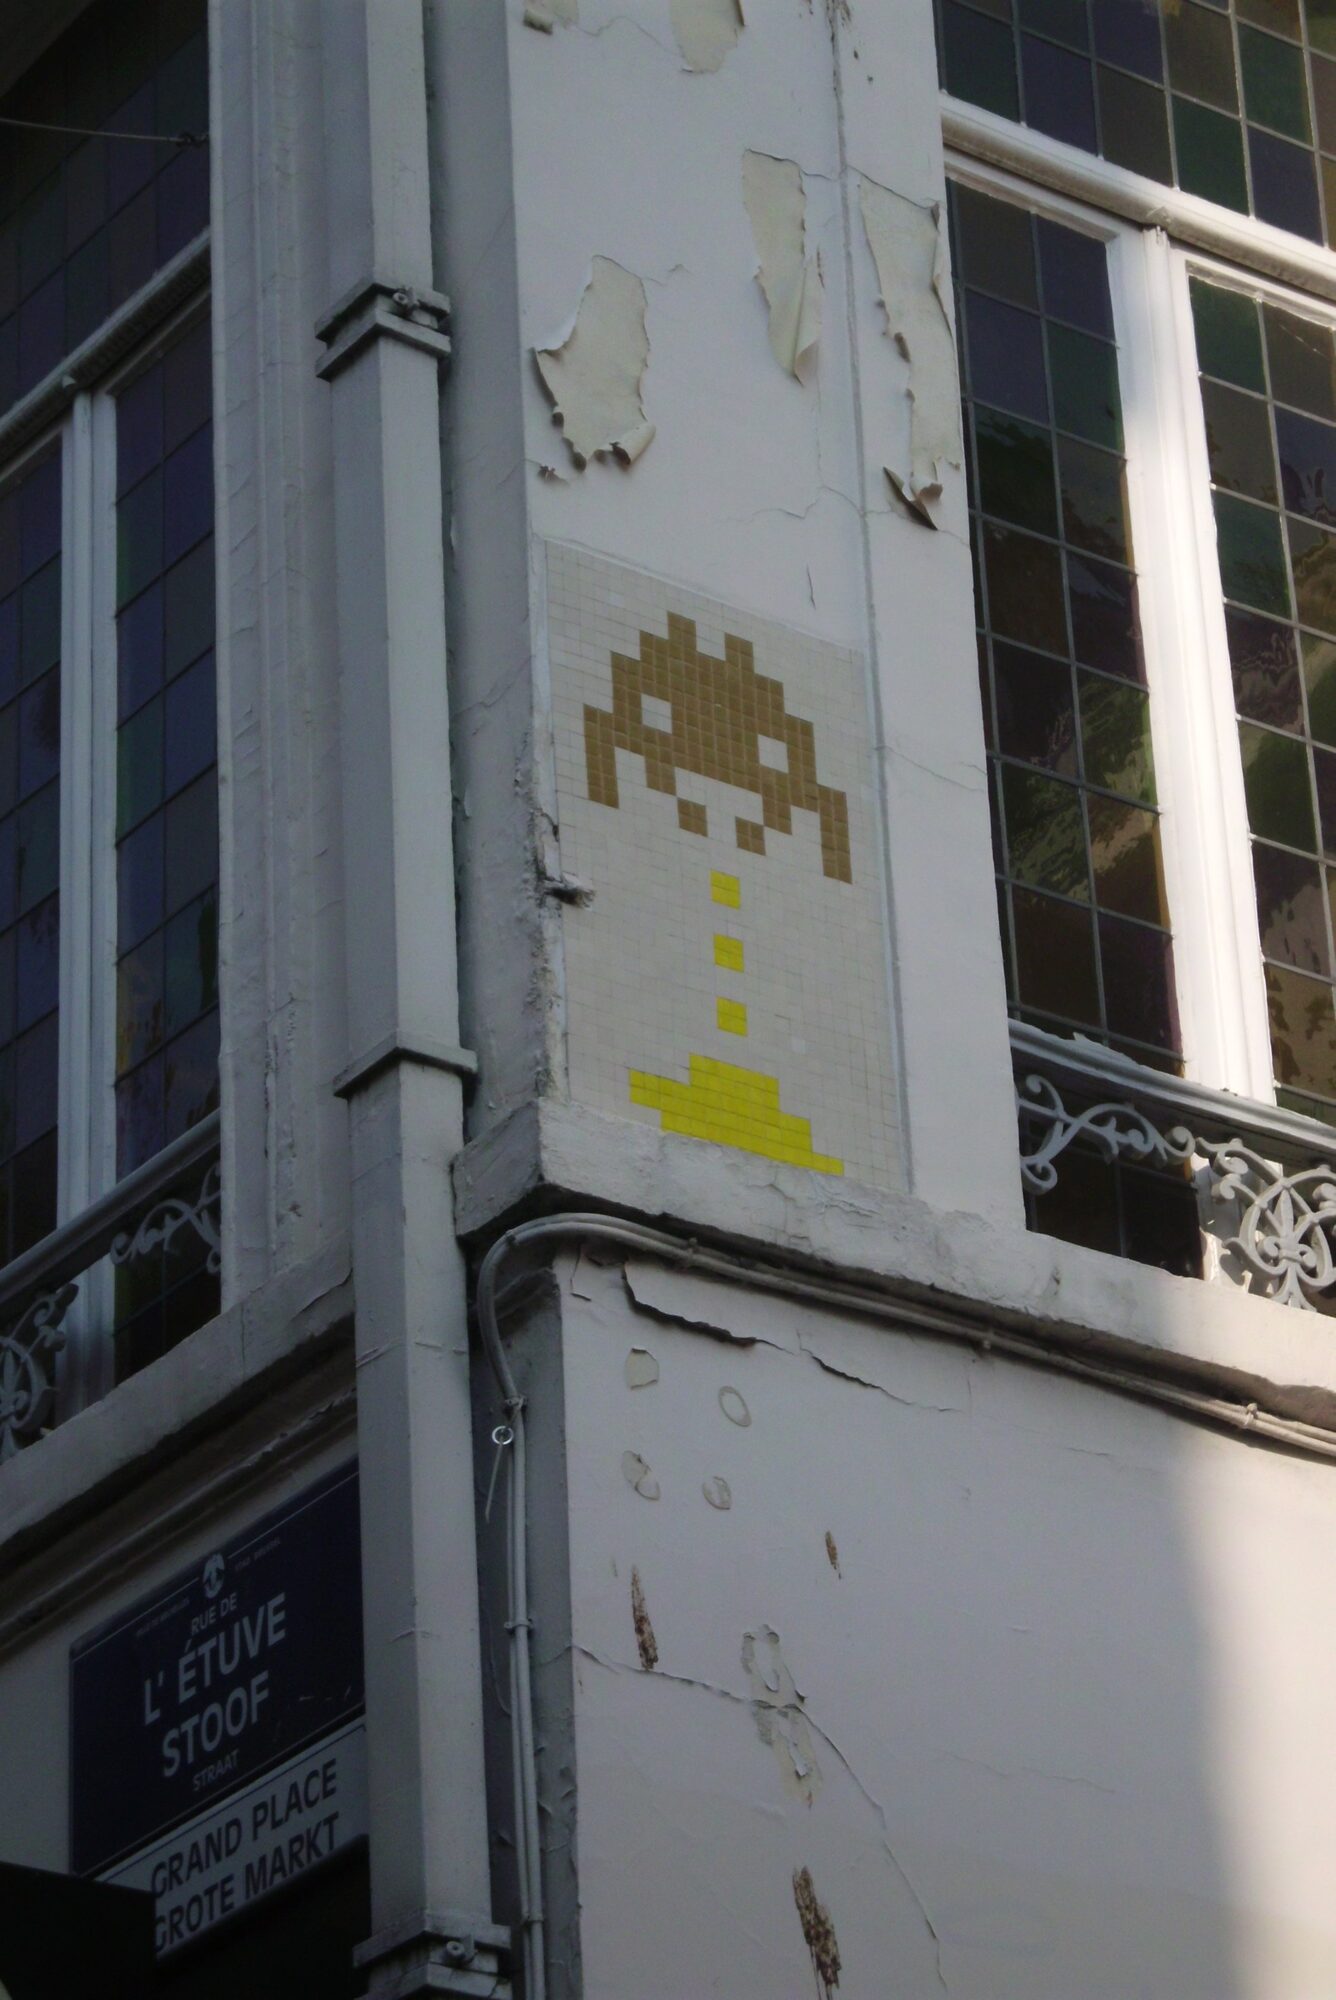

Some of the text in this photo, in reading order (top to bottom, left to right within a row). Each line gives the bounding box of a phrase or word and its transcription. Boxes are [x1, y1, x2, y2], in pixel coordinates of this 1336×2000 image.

[191, 1606, 217, 1636] RUE
[220, 1592, 237, 1617] DE
[162, 1670, 269, 1777] STOOF
[193, 1749, 239, 1791] STRAAT
[151, 1757, 337, 1898] GRAND PLACE
[155, 1811, 339, 1953] GROTE MARKT
